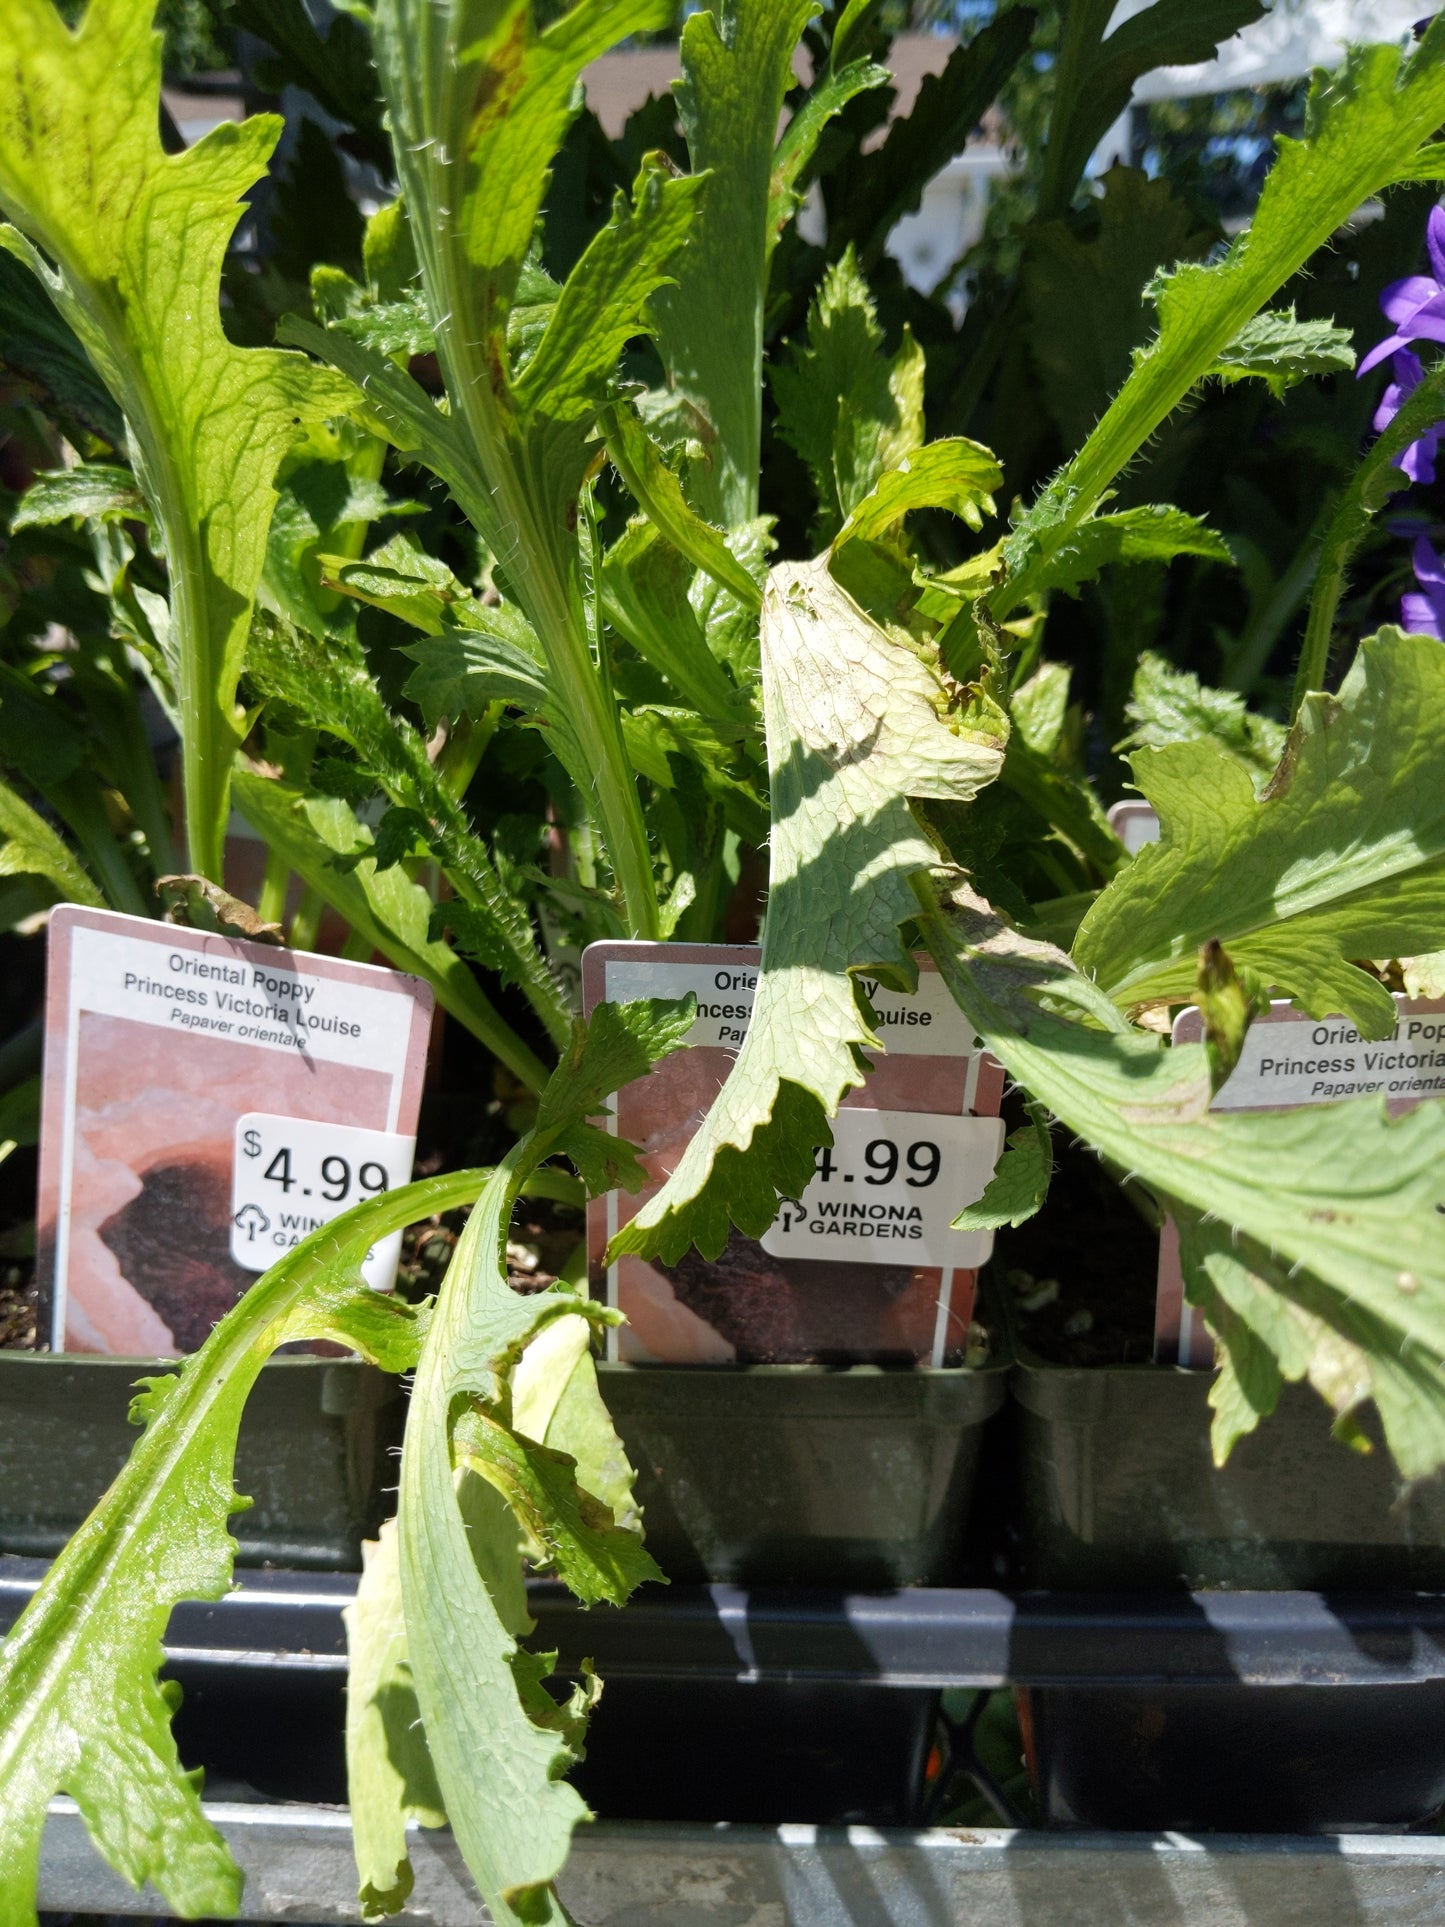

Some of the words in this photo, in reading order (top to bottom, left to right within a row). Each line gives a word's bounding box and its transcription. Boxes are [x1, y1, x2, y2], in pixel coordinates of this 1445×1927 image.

[169, 954, 246, 986] Oriental
[253, 971, 315, 1003] Poppy
[714, 971, 757, 991] Orie
[124, 972, 208, 1005] Princess
[215, 991, 289, 1023] Victoria
[296, 1008, 361, 1037] Louise
[171, 1008, 234, 1033] Papaver
[238, 1026, 307, 1049] orientale
[1407, 1022, 1445, 1043] Pop
[1260, 1058, 1355, 1076] Princess
[1311, 1081, 1385, 1098] Papaver
[1388, 1076, 1445, 1092] orienta
[818, 1201, 923, 1221] WINONA
[280, 1212, 324, 1231] WIN
[809, 1220, 923, 1239] GARDENS
